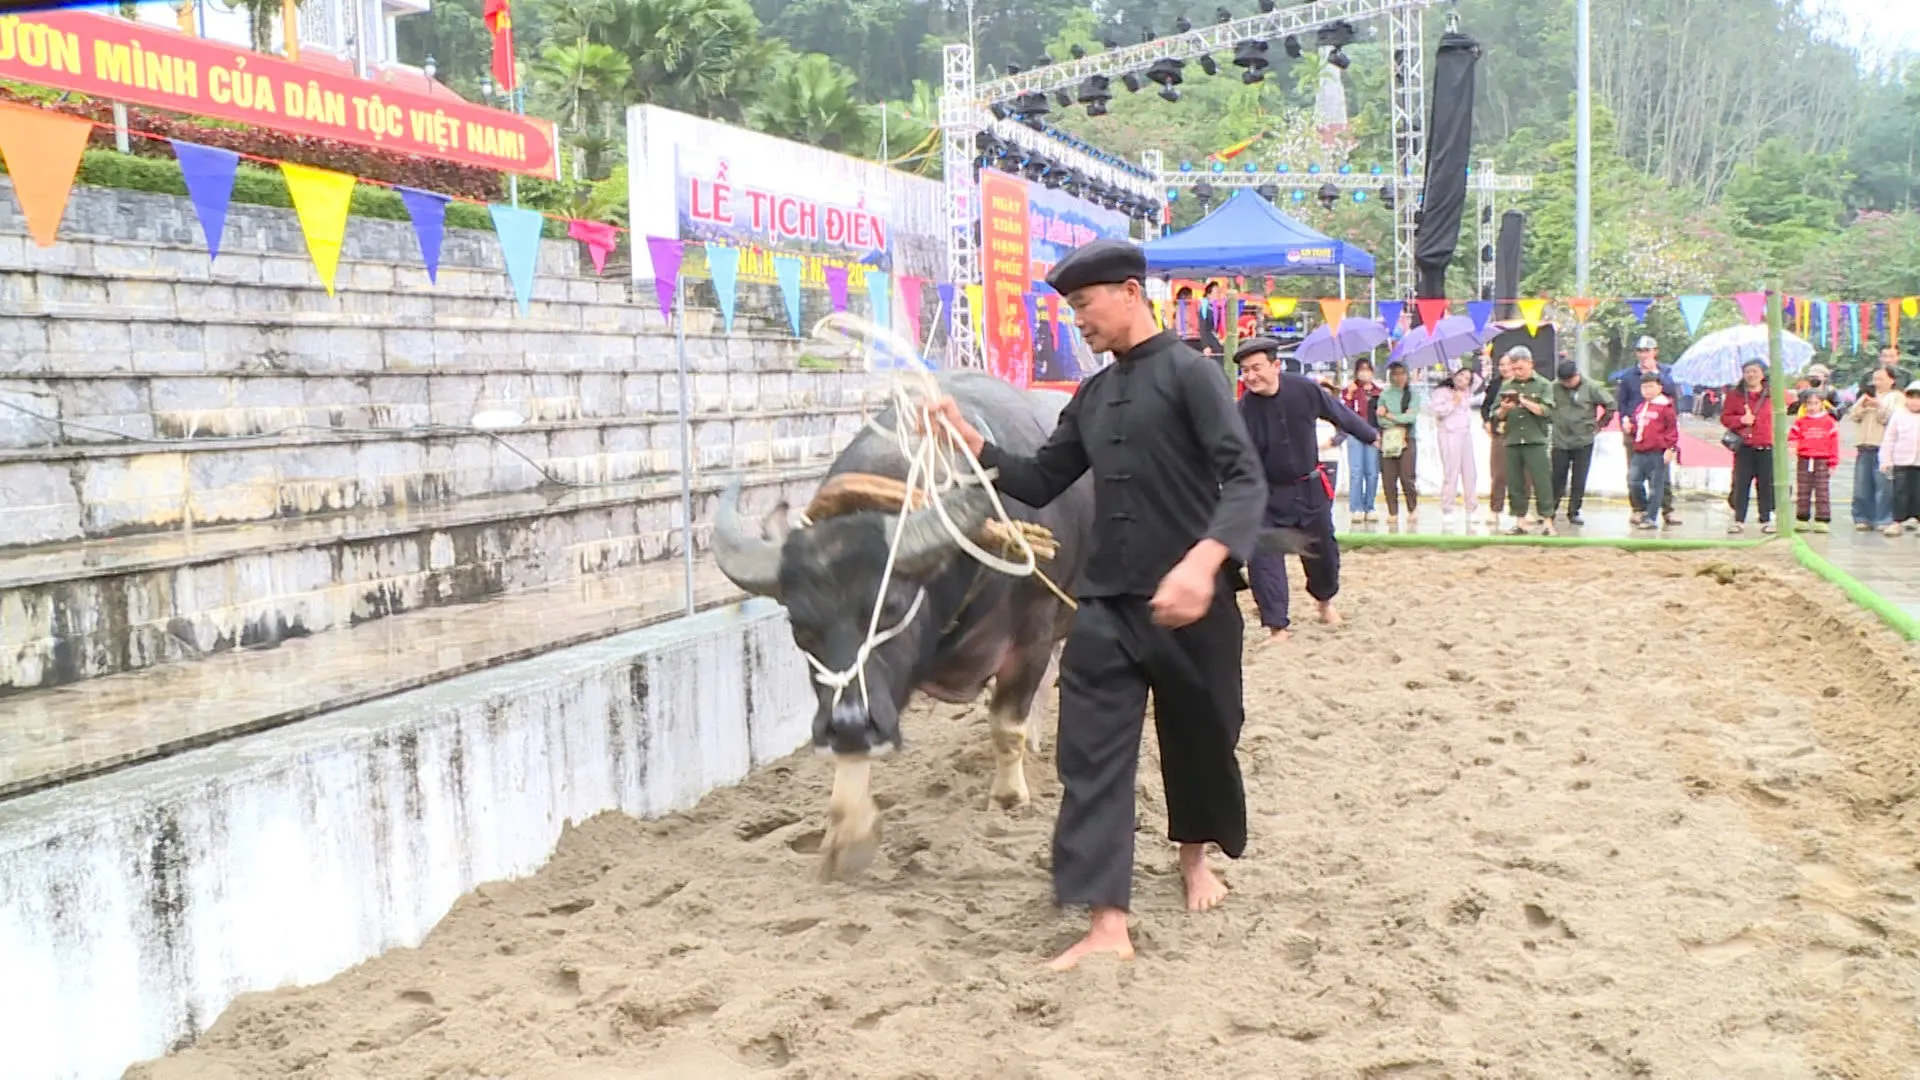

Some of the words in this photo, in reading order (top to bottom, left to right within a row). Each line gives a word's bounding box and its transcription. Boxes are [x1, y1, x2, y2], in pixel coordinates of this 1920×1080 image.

[94, 39, 198, 98] MÌNH
[208, 56, 276, 113] CỦA
[284, 80, 346, 127] DÂN
[352, 94, 404, 141] TỘC
[409, 108, 461, 152] VIỆT
[466, 121, 526, 162] NAM!
[691, 161, 732, 223] LỄ
[745, 190, 817, 241] TỊCH
